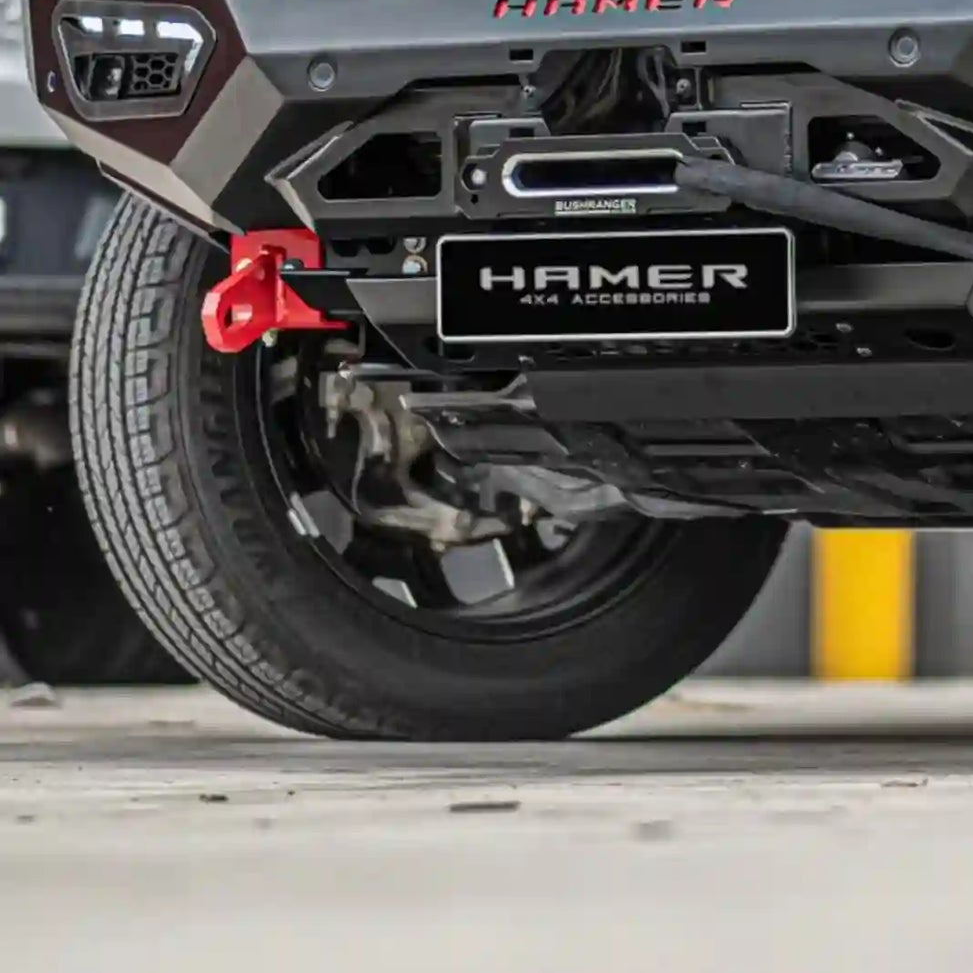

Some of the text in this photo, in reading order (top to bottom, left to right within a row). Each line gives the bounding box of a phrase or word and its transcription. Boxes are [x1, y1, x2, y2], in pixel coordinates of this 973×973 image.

[555, 198, 636, 211] BUSHRANGER
[480, 264, 748, 290] HAMER
[571, 292, 711, 305] ACCESSORIES
